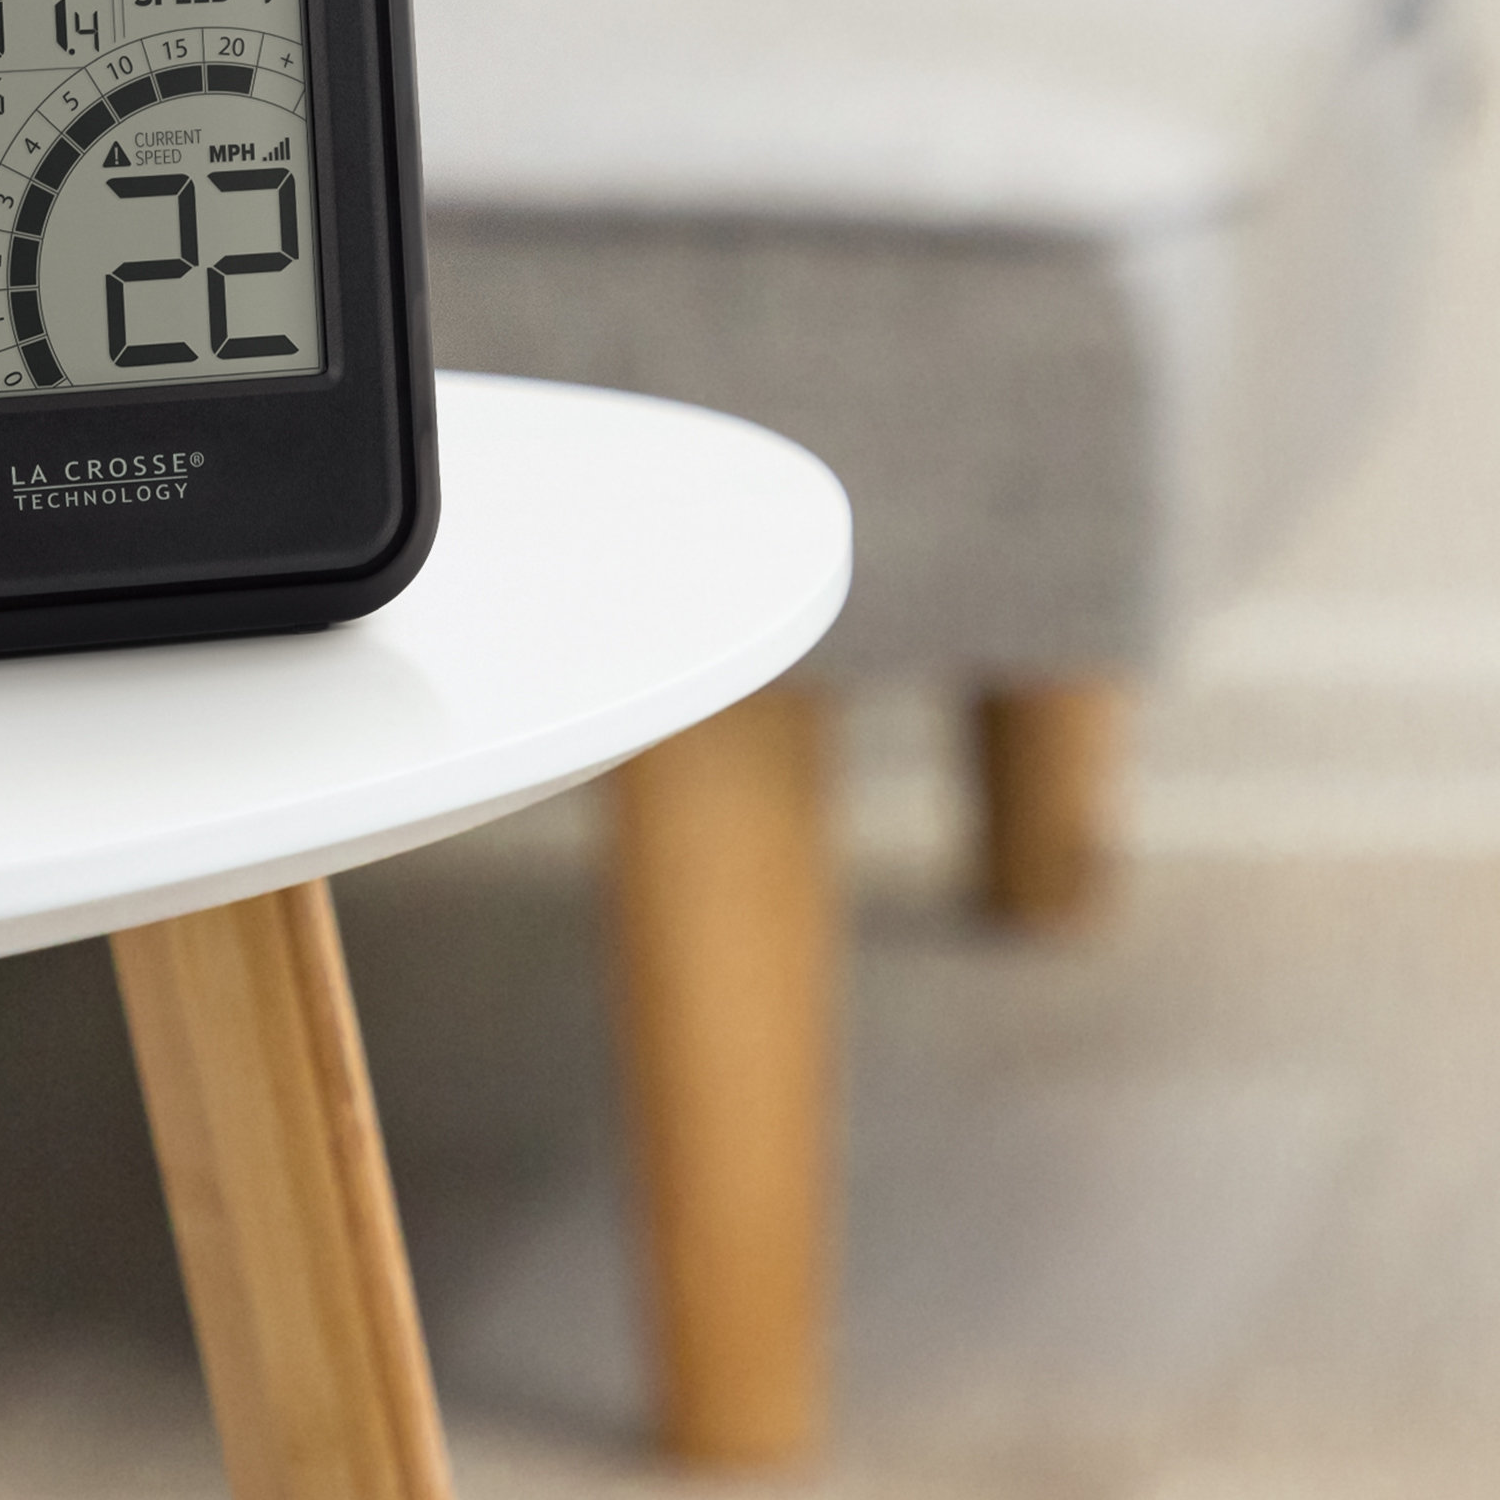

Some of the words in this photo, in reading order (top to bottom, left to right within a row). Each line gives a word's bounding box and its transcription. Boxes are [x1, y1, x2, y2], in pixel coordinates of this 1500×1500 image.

[162, 39, 188, 59] 15
[218, 37, 245, 56] 20
[106, 55, 134, 80] 10
[61, 91, 79, 111] 5
[24, 138, 42, 154] 4
[134, 129, 202, 147] CURRENT
[135, 149, 182, 166] SPEED
[209, 143, 255, 163] MPH
[106, 167, 299, 368] 22
[4, 371, 23, 386] 0
[11, 464, 47, 485] LA
[13, 482, 187, 511] TECHNOLOGY
